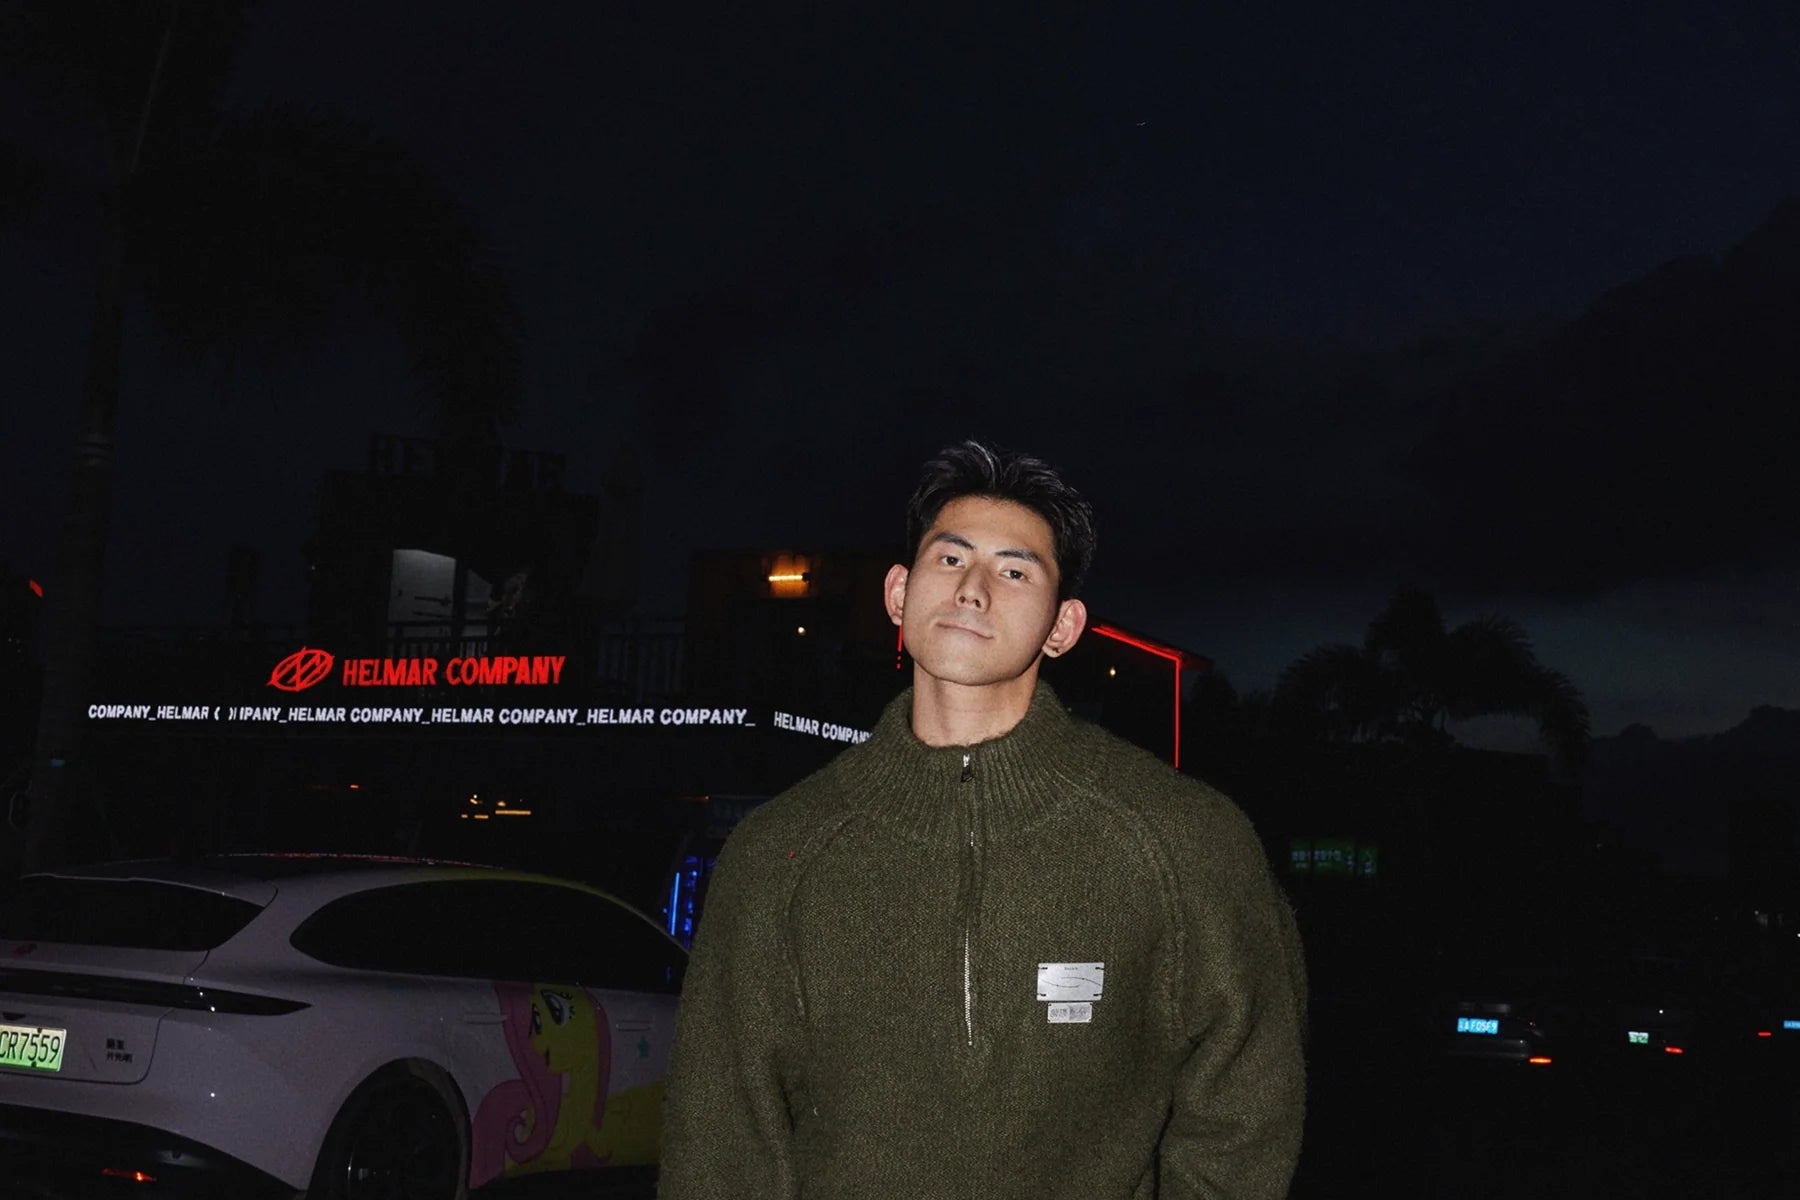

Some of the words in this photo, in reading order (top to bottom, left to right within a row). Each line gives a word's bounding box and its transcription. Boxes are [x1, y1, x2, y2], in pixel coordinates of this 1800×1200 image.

[342, 657, 439, 687] HELMAR
[445, 655, 566, 686] COMPANY
[773, 711, 820, 736] HELMAR
[0, 1031, 61, 1064] CR7559
